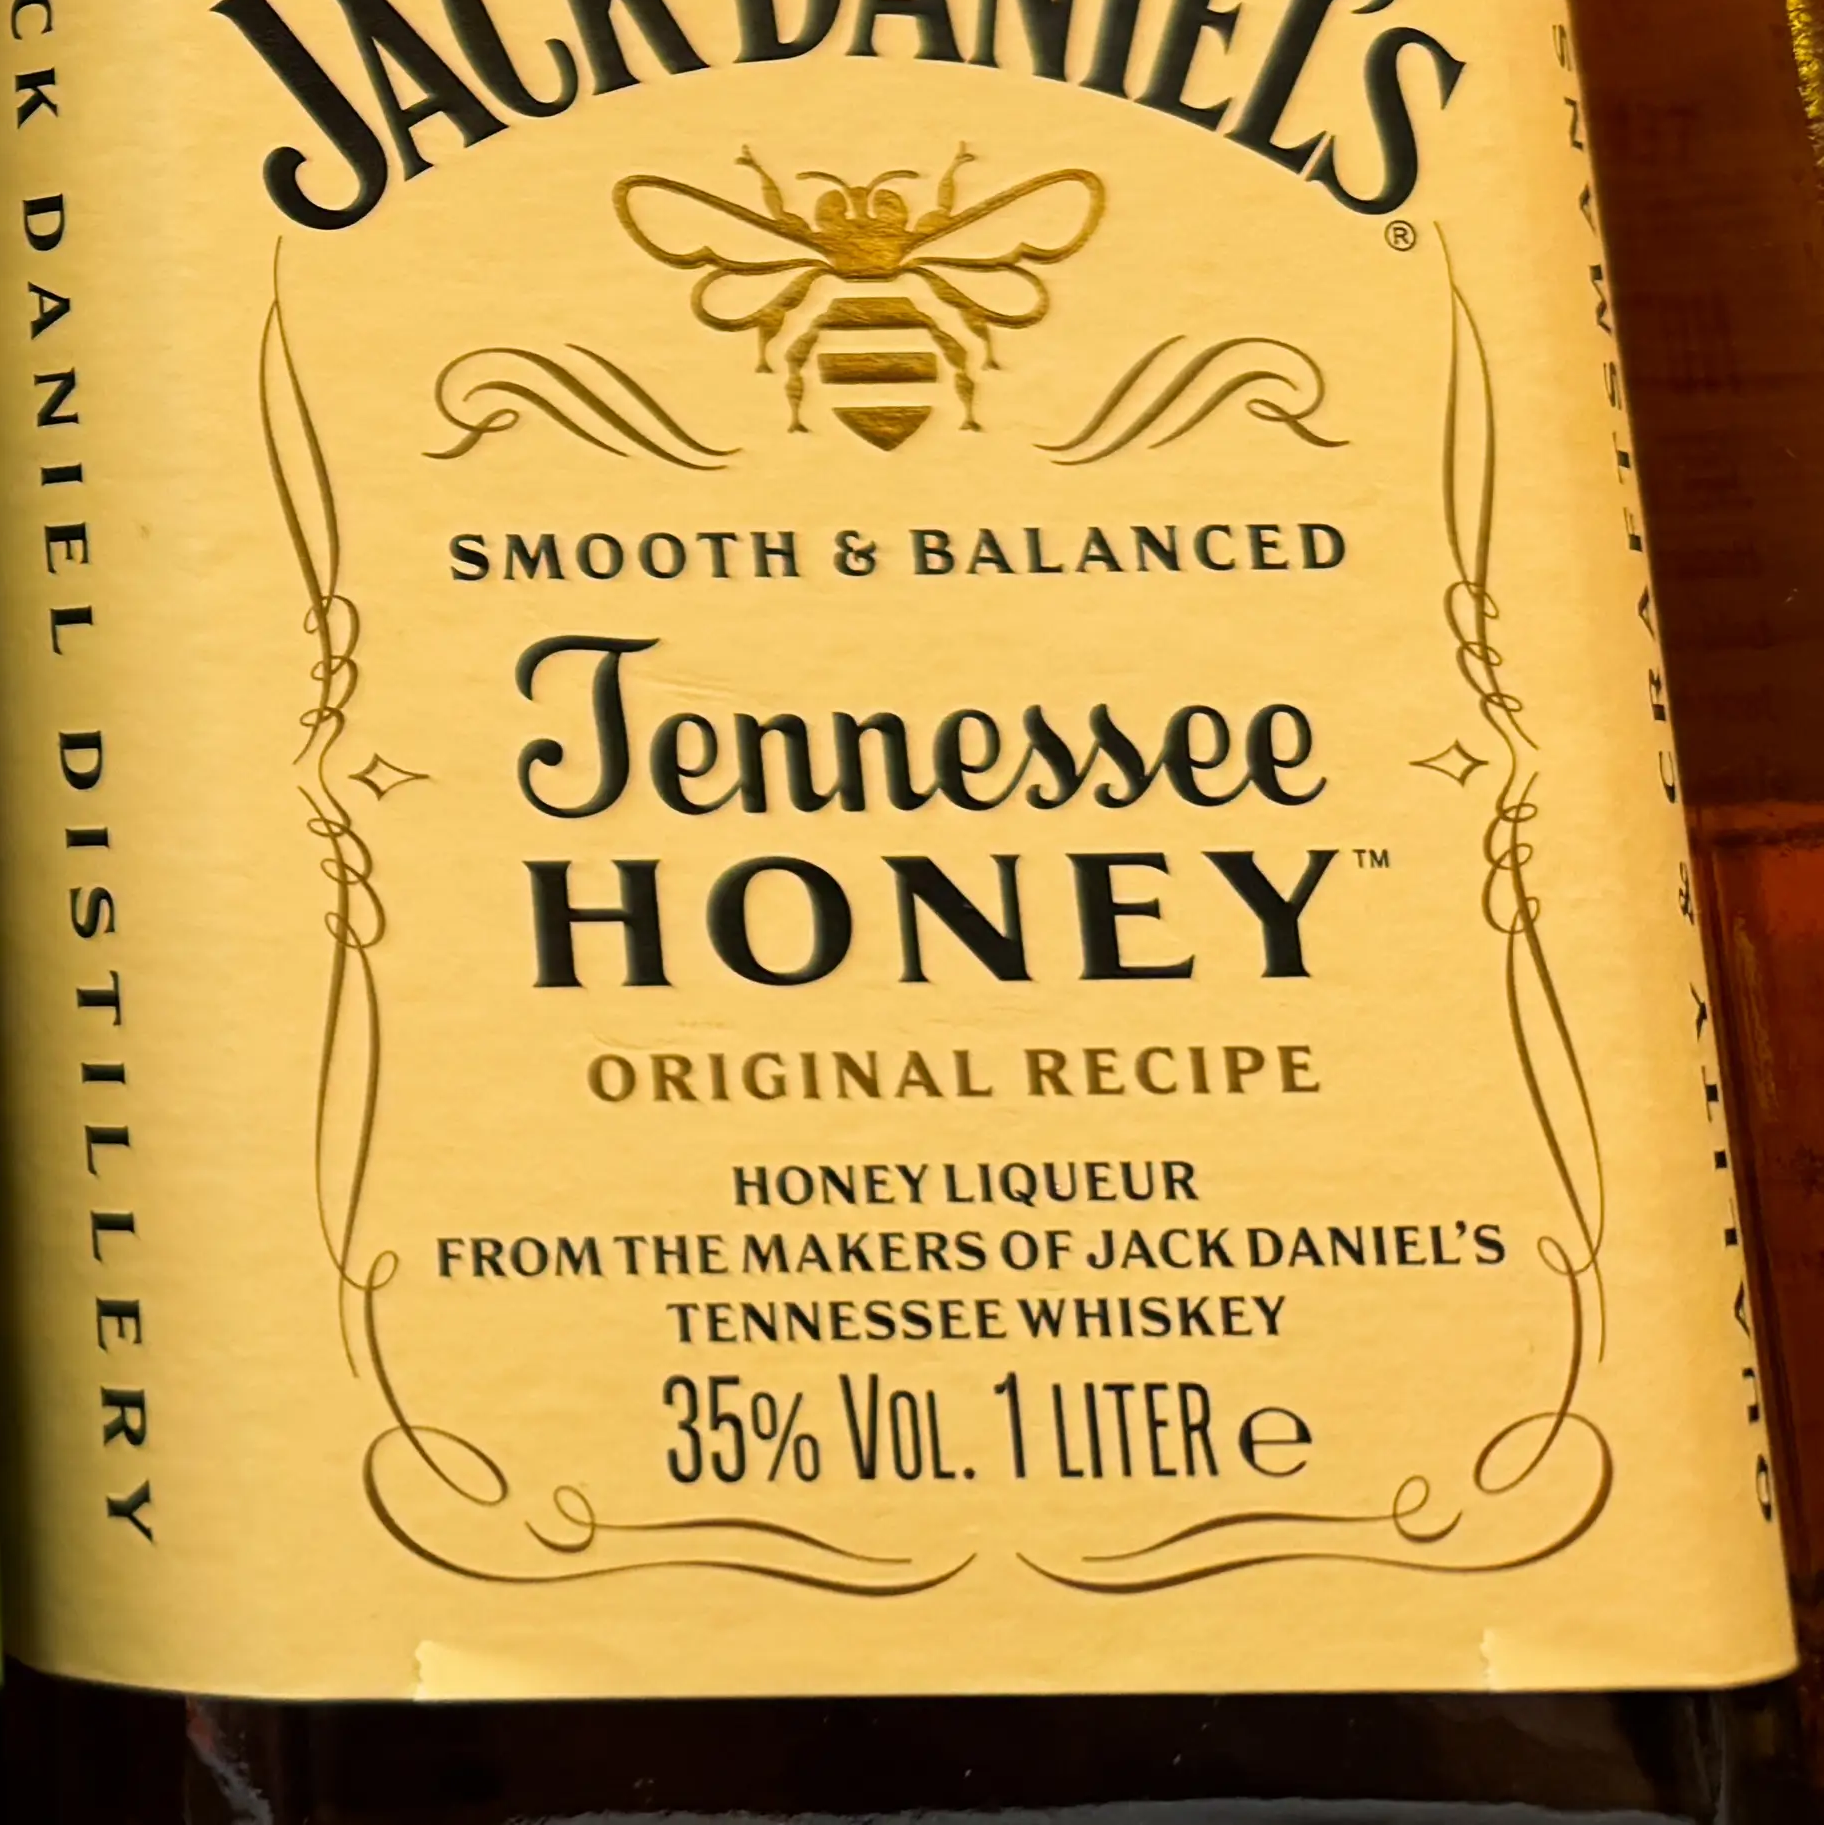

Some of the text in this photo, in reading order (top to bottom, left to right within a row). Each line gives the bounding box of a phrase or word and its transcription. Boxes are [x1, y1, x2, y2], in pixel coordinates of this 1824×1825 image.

[451, 524, 1345, 581] SMOOTH & BALANCED
[517, 636, 1326, 818] Tennessee
[20, 192, 94, 656] DANIEL
[57, 730, 155, 1546] DISTILLERY
[589, 1046, 1319, 1102] ORIGINAL RECIPE
[734, 1161, 1198, 1207] HONEY LIQUEUR
[439, 1221, 1505, 1277] FROM THE MAKERS OF JACK DANIEL'S
[667, 1296, 1284, 1342] TENNESSEE WHISKEY
[664, 1376, 820, 1483] 35%
[995, 1372, 1025, 1478] 1
[1053, 1383, 1218, 1478] LITER
